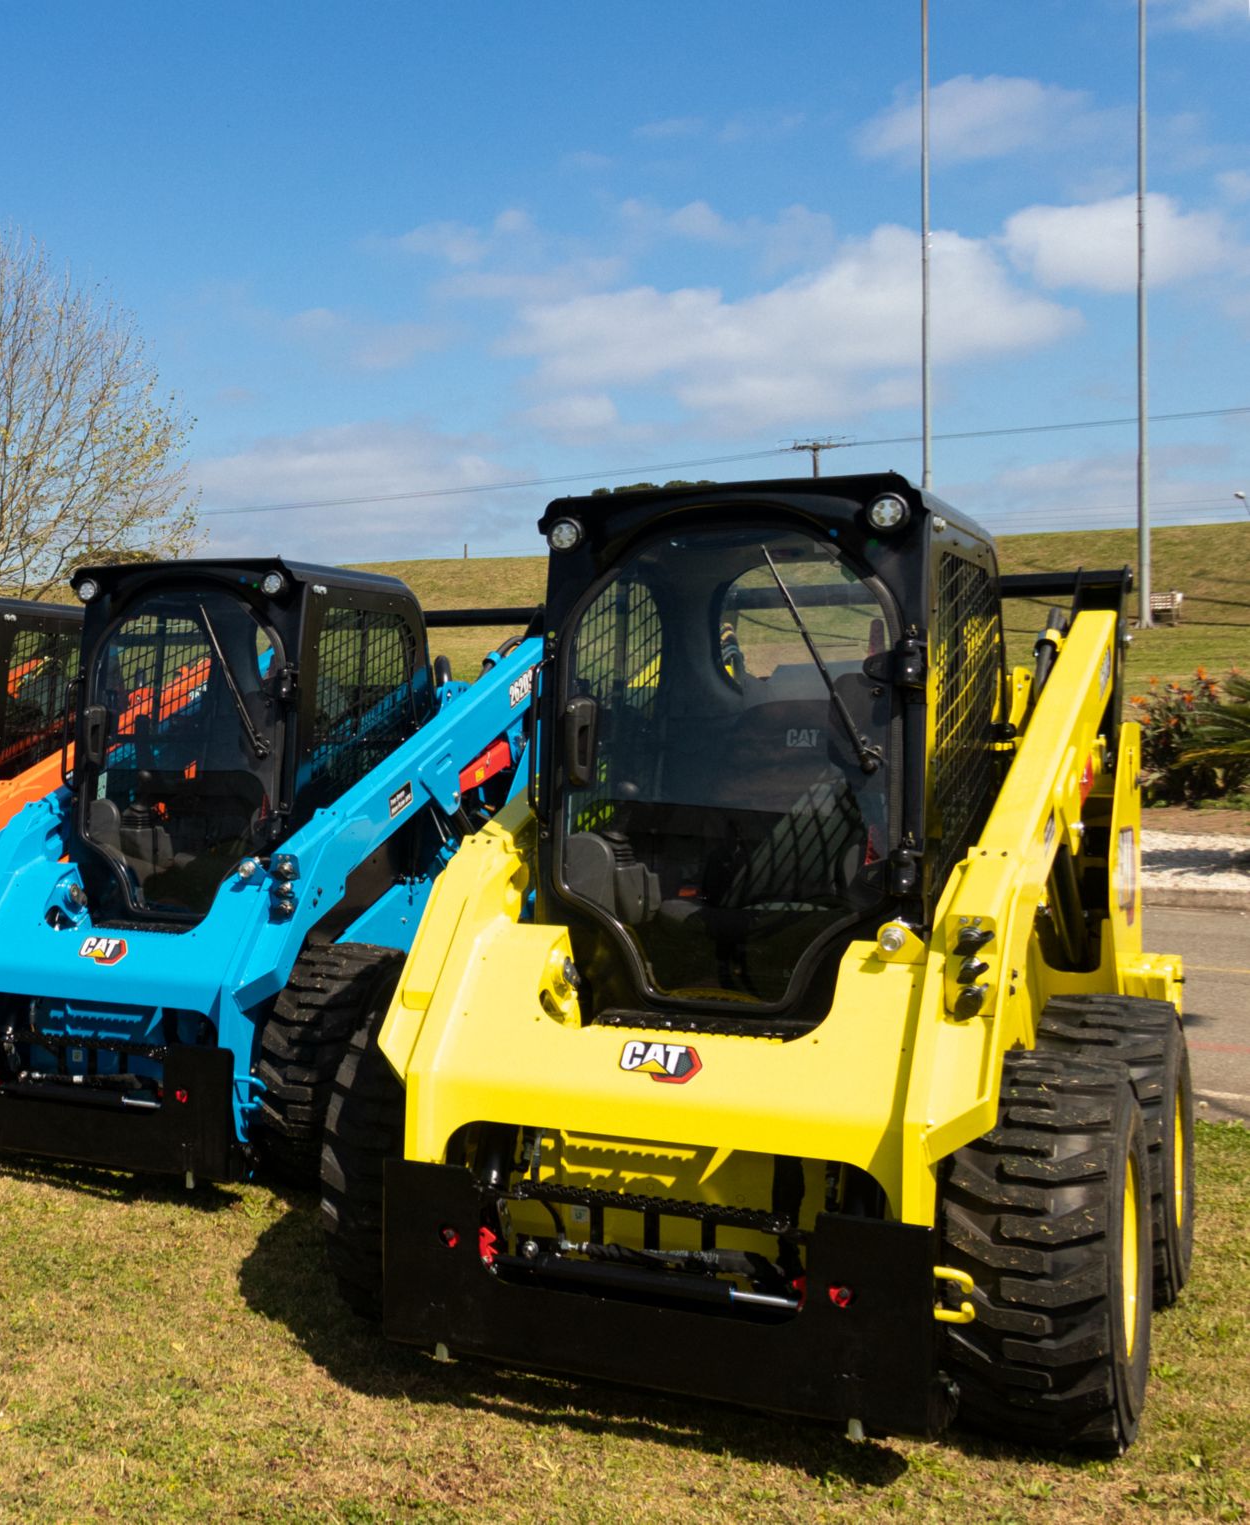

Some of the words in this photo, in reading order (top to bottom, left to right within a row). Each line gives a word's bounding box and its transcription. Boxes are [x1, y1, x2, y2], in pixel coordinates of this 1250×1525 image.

[786, 728, 821, 748] CAT
[80, 937, 120, 959] CAT
[620, 1040, 687, 1075] CAT
